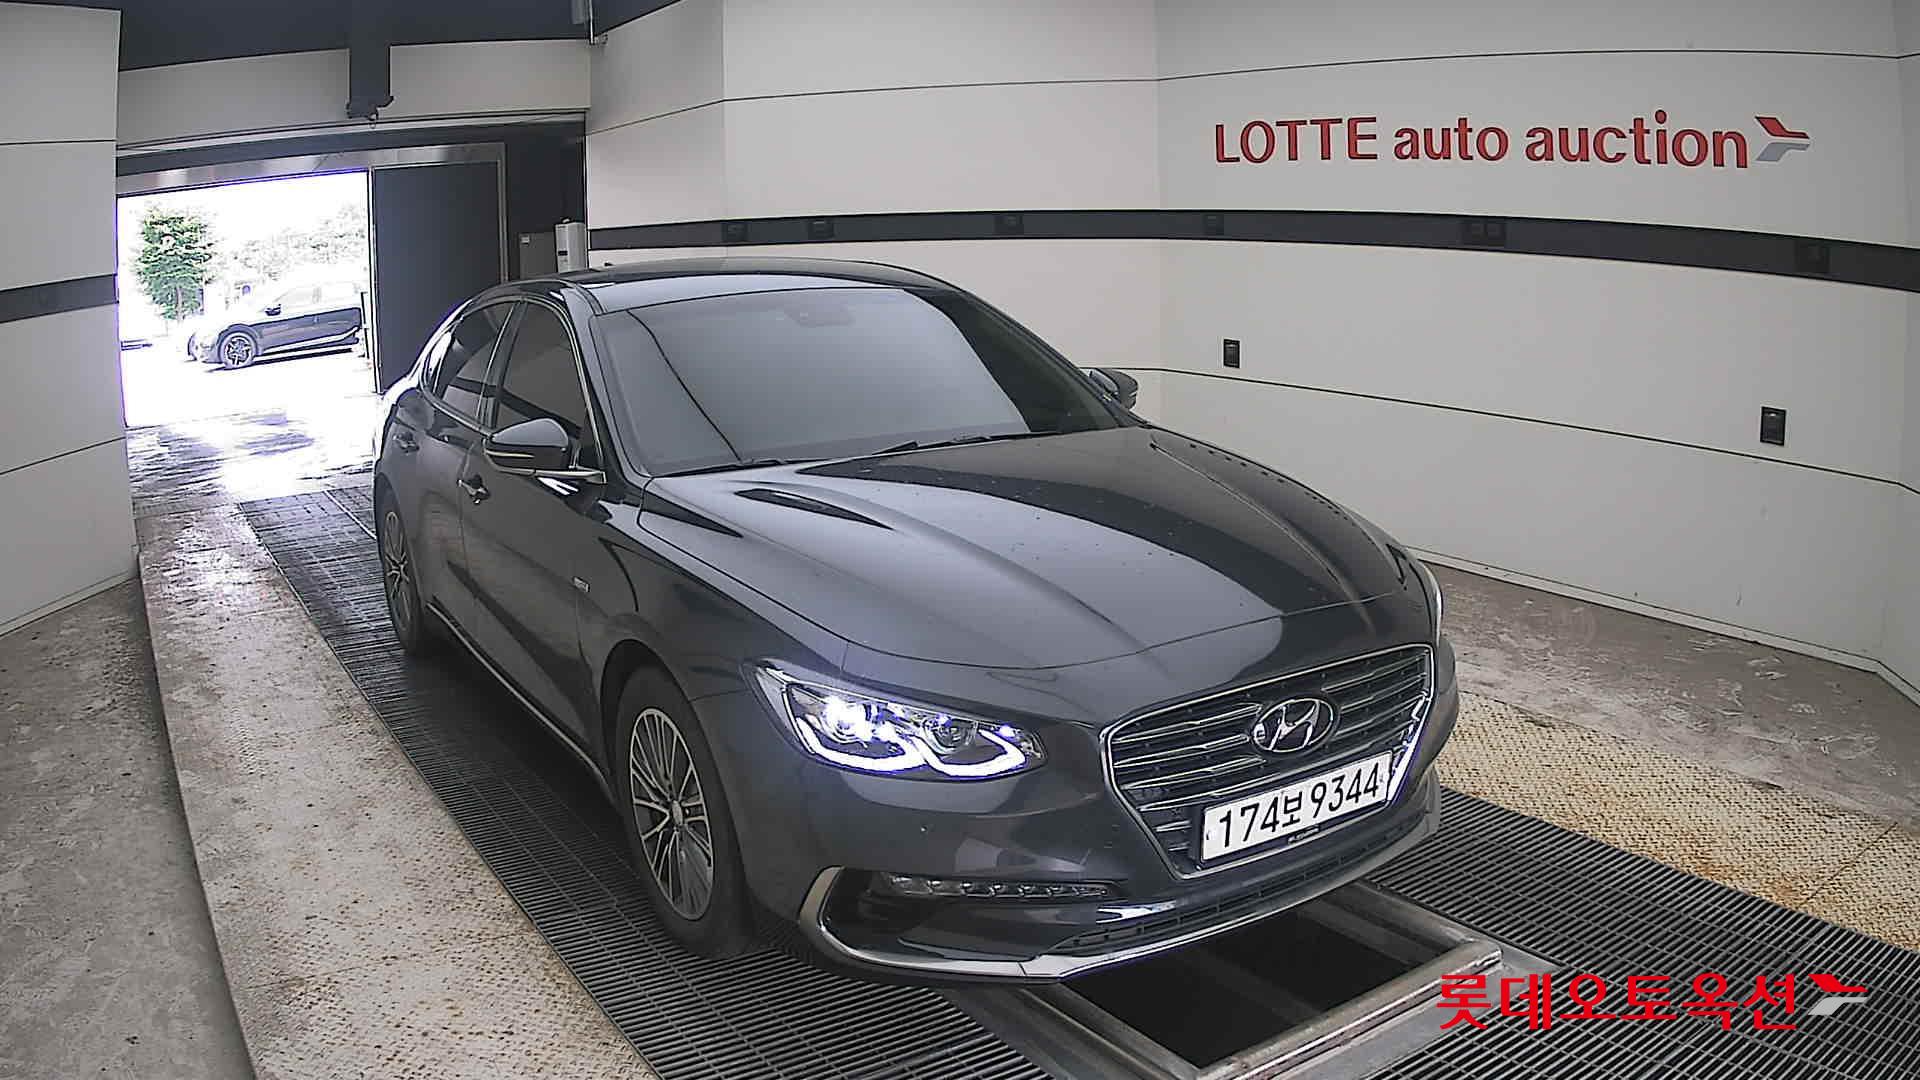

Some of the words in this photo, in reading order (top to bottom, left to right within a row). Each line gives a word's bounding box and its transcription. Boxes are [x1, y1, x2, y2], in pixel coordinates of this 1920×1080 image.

[1215, 116, 1377, 164] LOTTE
[1392, 117, 1511, 163] auto
[1524, 111, 1750, 169] auction
